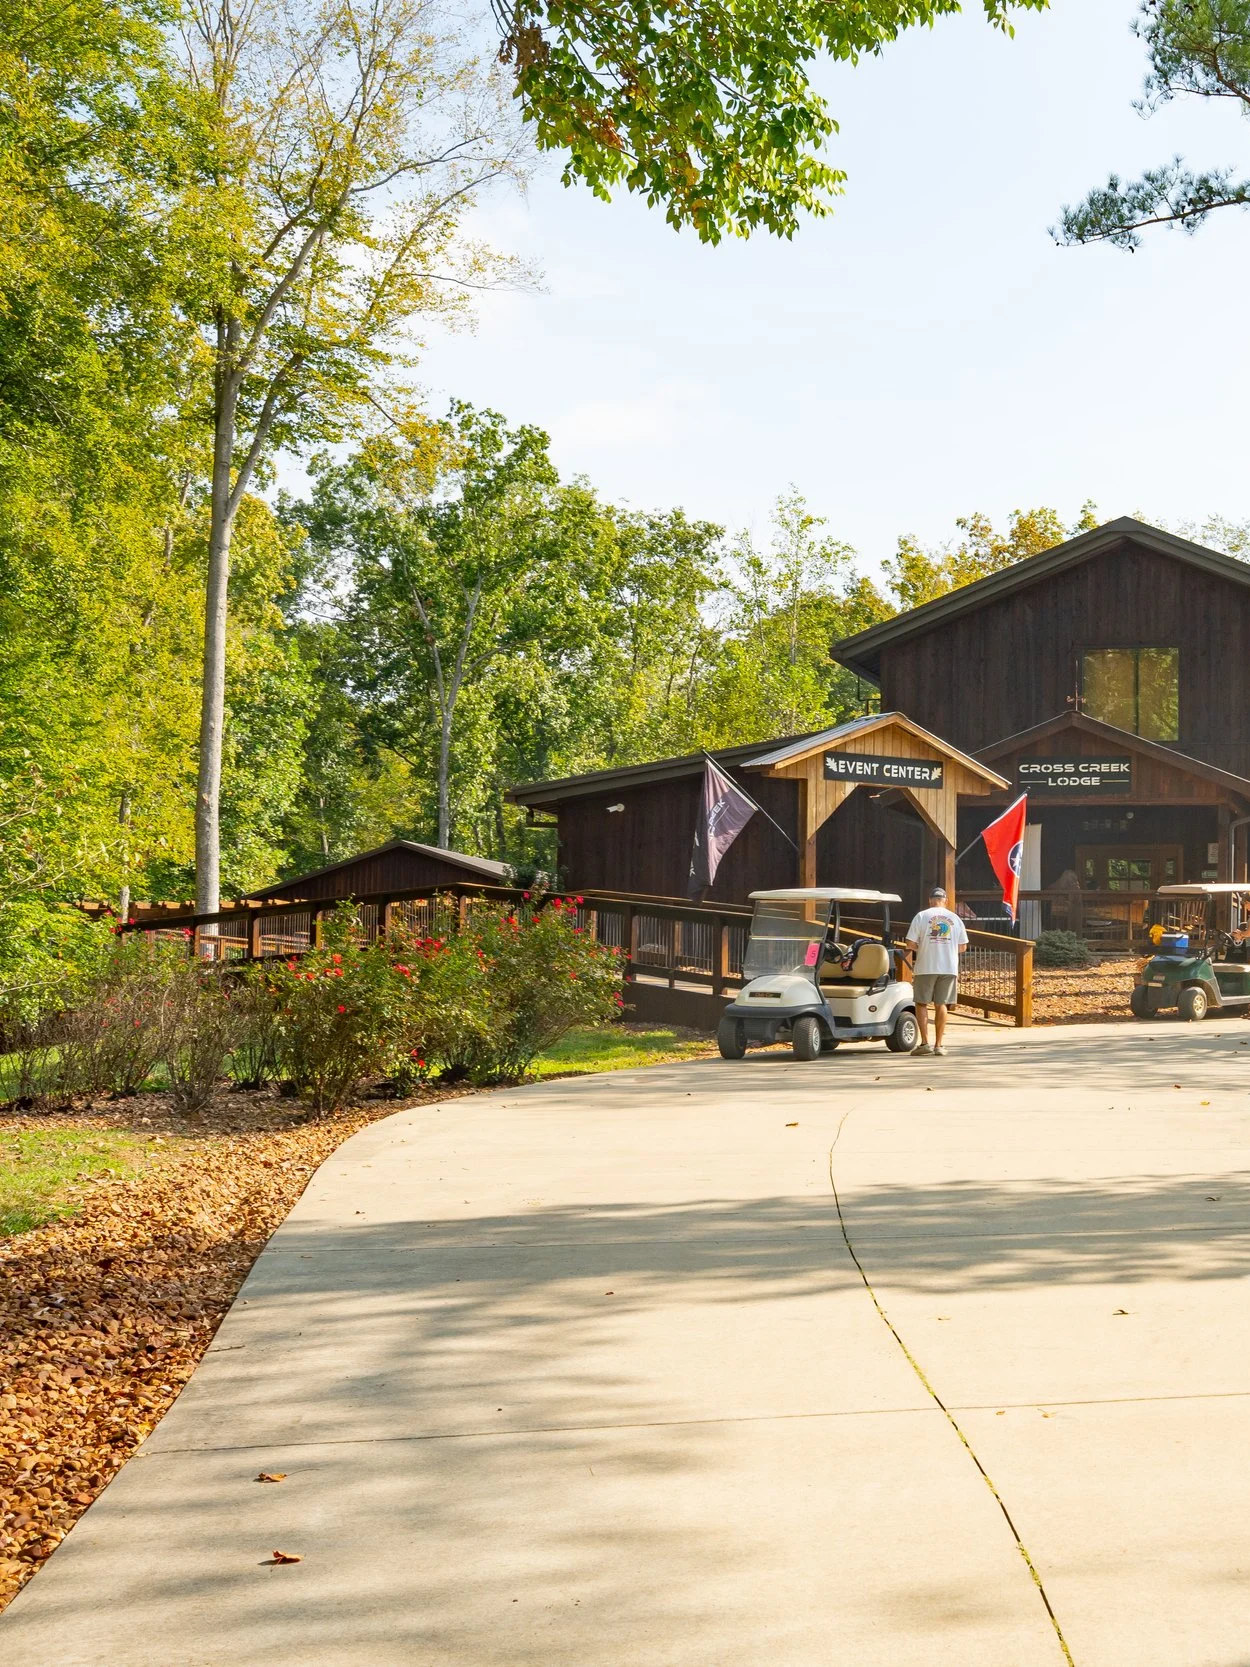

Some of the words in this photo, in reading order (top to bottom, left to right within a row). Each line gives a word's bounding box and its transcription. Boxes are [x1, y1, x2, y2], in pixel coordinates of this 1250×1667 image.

[838, 760, 880, 776] EVENT
[883, 764, 930, 781] CENTER
[1019, 763, 1075, 773] CROSS
[1078, 763, 1130, 773] CREEK
[1048, 777, 1101, 786] LODGE
